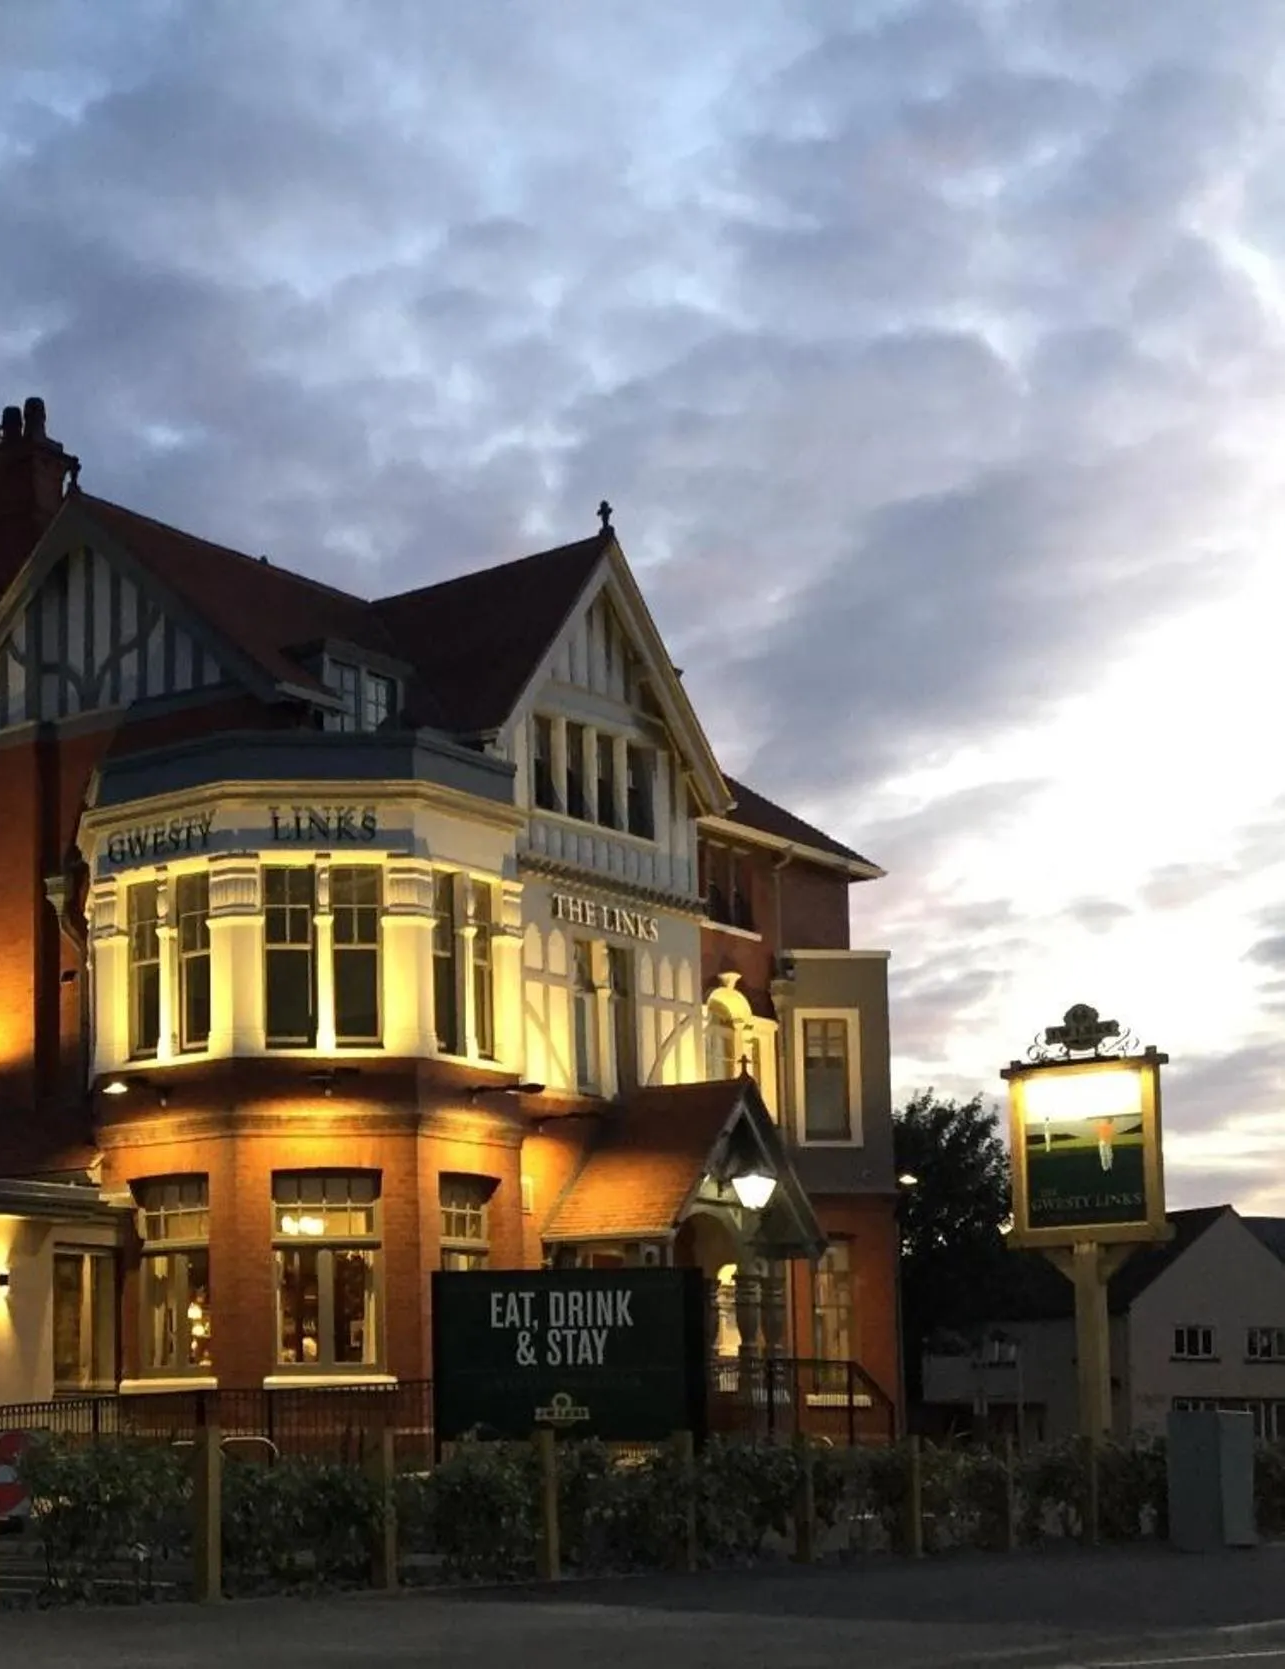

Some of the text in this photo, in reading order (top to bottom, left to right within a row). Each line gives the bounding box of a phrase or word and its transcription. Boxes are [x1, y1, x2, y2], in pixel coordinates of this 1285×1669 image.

[107, 807, 377, 864] GWESTY LINKS
[552, 893, 659, 942] THE LINKS
[1095, 1192, 1143, 1208] LINKS
[490, 1290, 634, 1331] EAT, DRINK
[517, 1329, 608, 1366] & STAY
